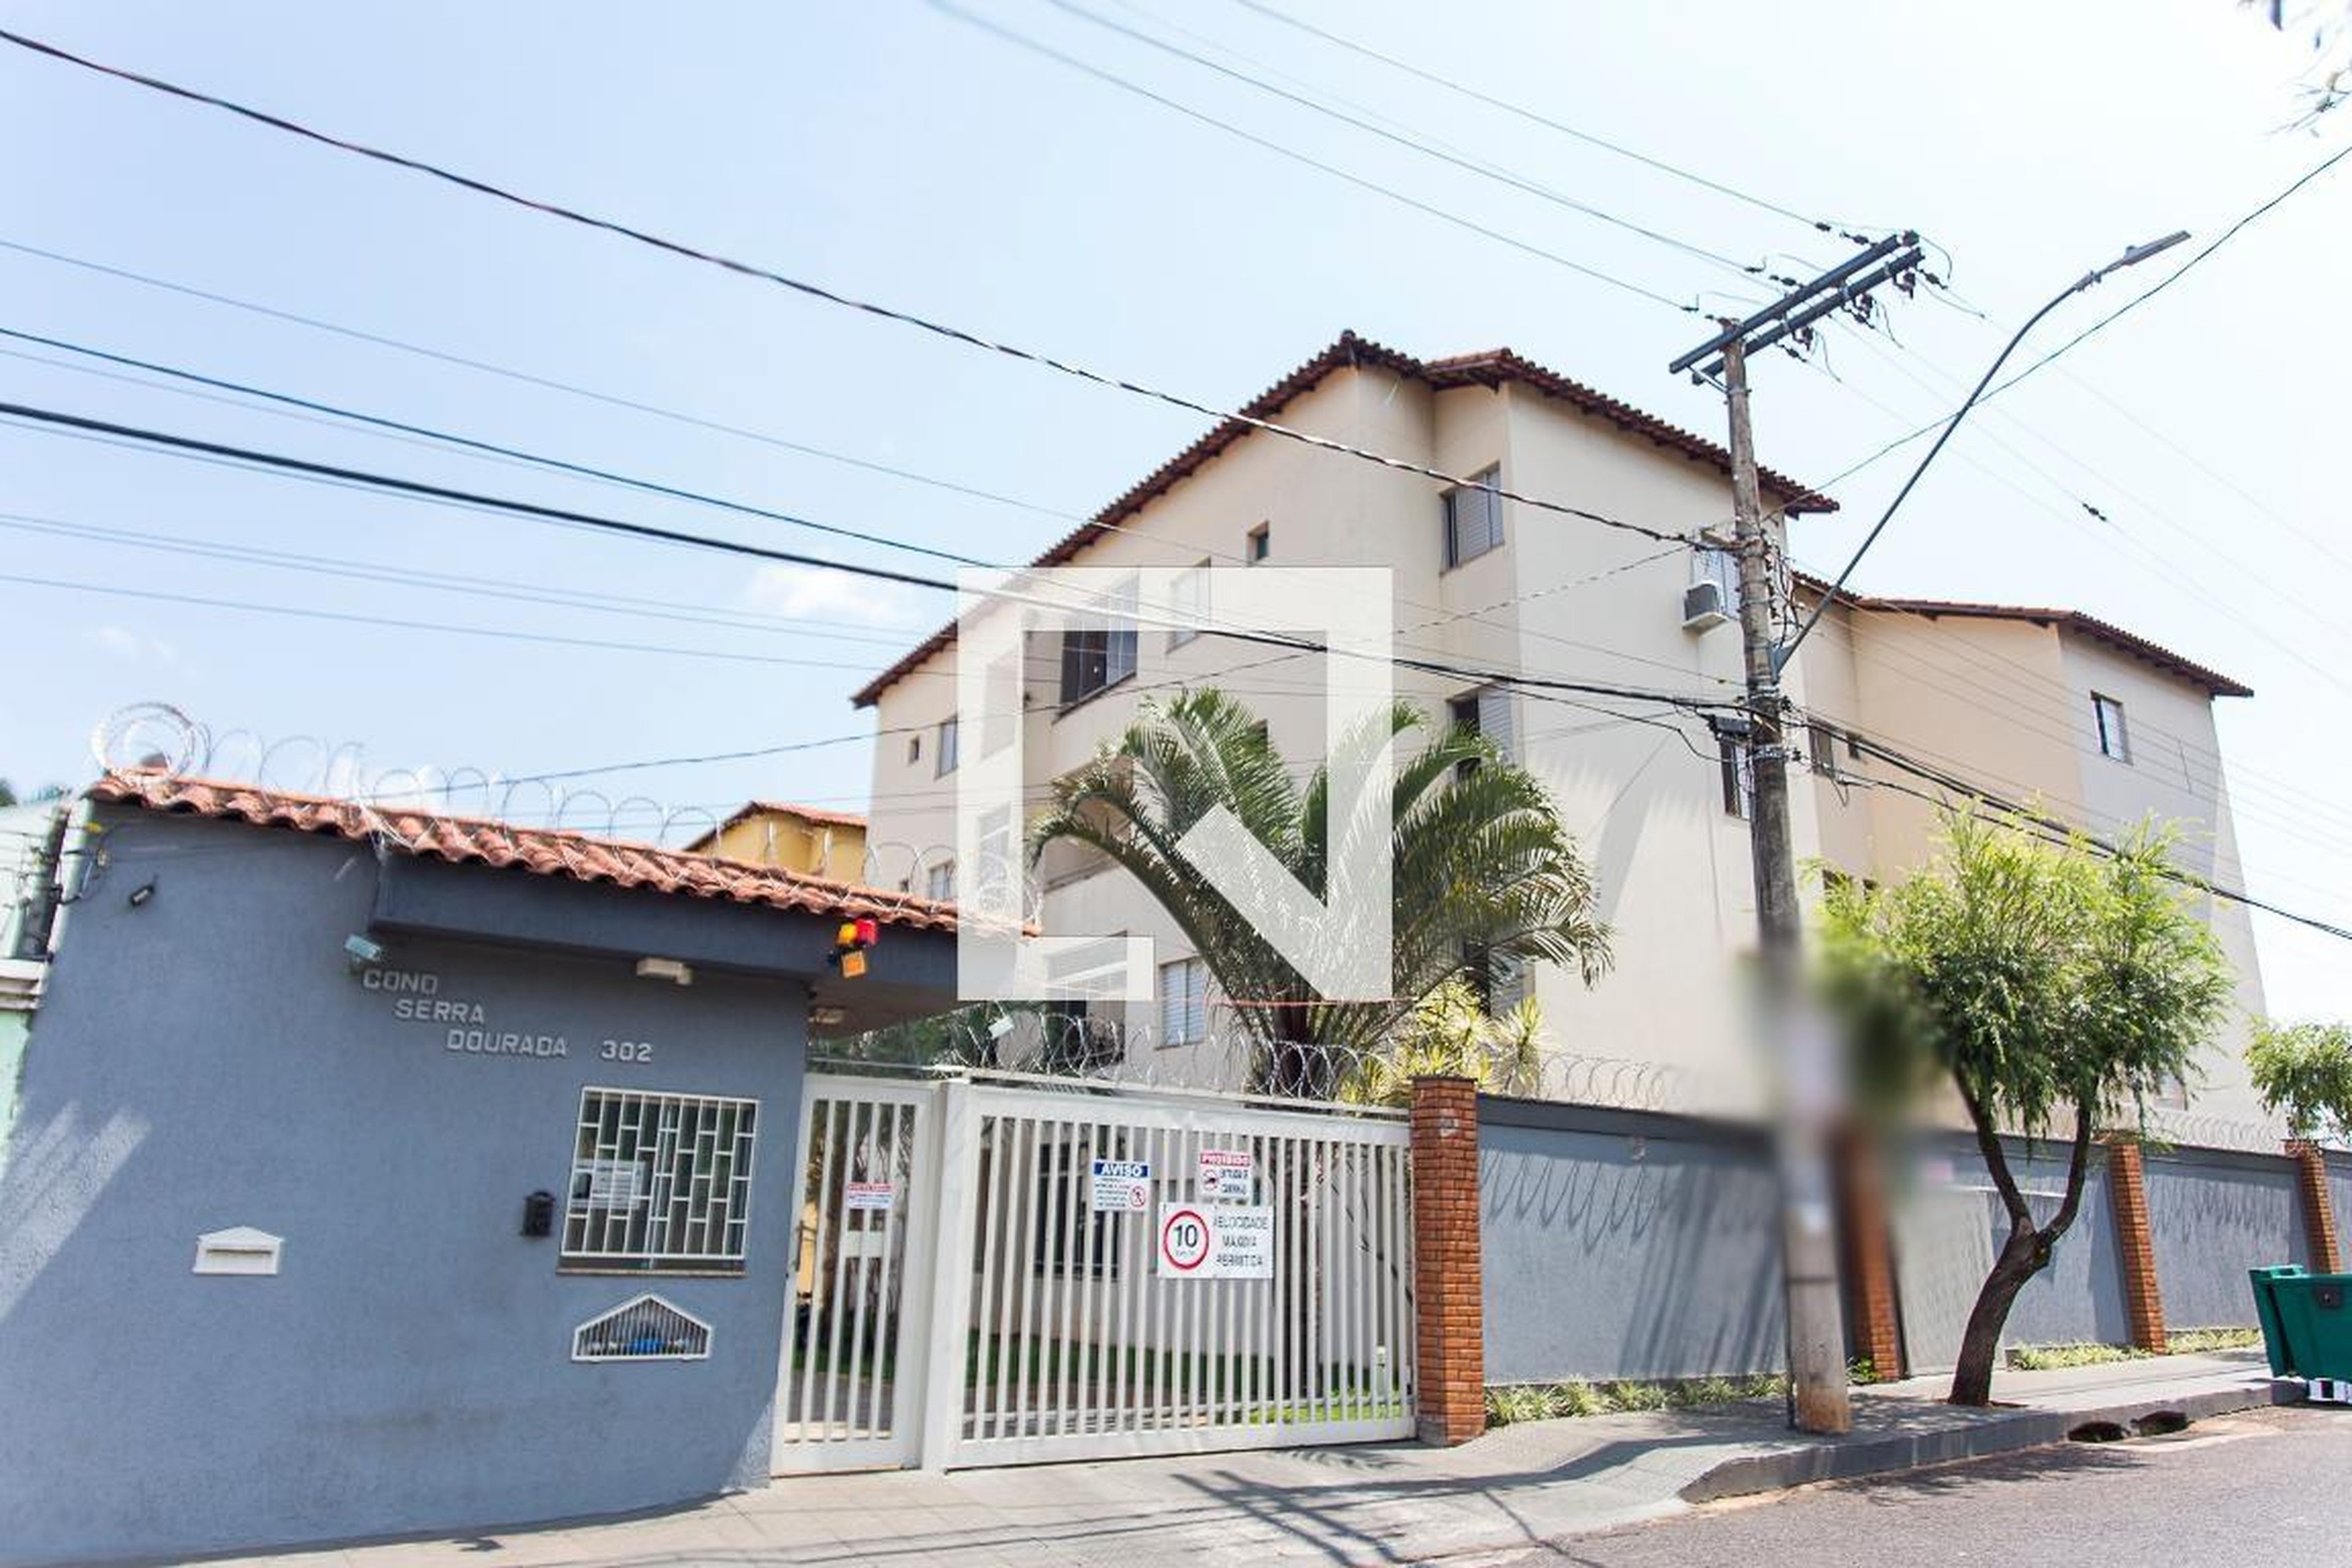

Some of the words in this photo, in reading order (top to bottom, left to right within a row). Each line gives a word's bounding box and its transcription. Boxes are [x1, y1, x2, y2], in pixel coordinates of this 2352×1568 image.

[394, 999, 485, 1025] SERRA
[447, 1029, 567, 1057] DOURADA
[601, 1040, 652, 1062] 302
[1101, 1163, 1142, 1177] AVISO
[1174, 1224, 1198, 1248] 10
